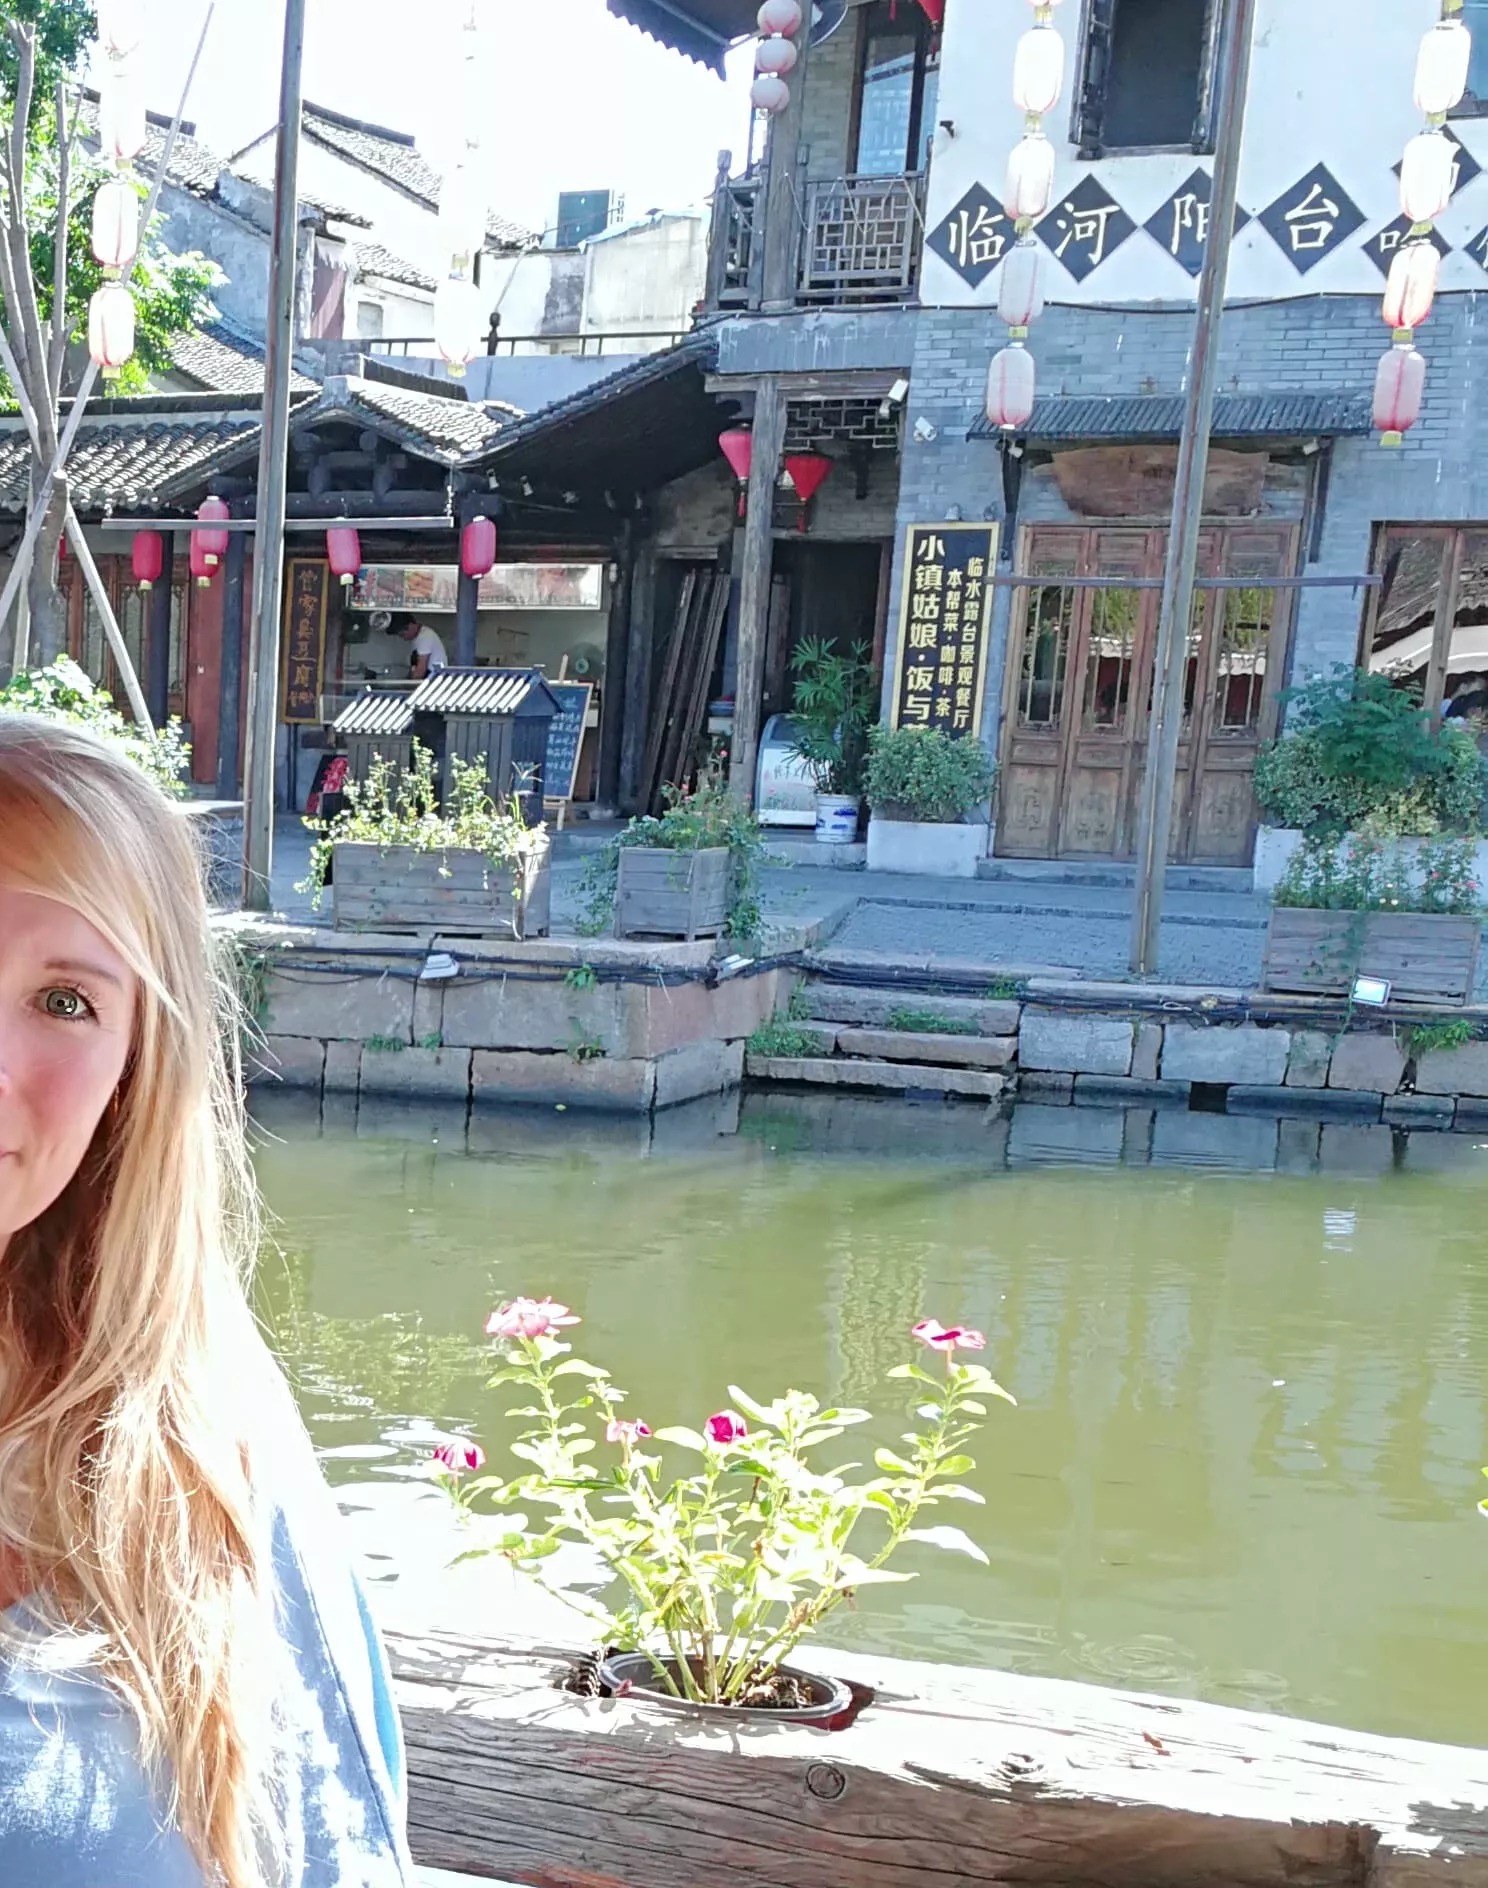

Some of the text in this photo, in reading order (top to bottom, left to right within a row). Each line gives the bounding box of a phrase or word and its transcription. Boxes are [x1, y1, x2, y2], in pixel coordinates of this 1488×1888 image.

[949, 183, 1340, 266] 临河阳台
[903, 535, 945, 730] 小镇姑娘·饭与
[953, 557, 984, 728] 临水露台景观餐厅
